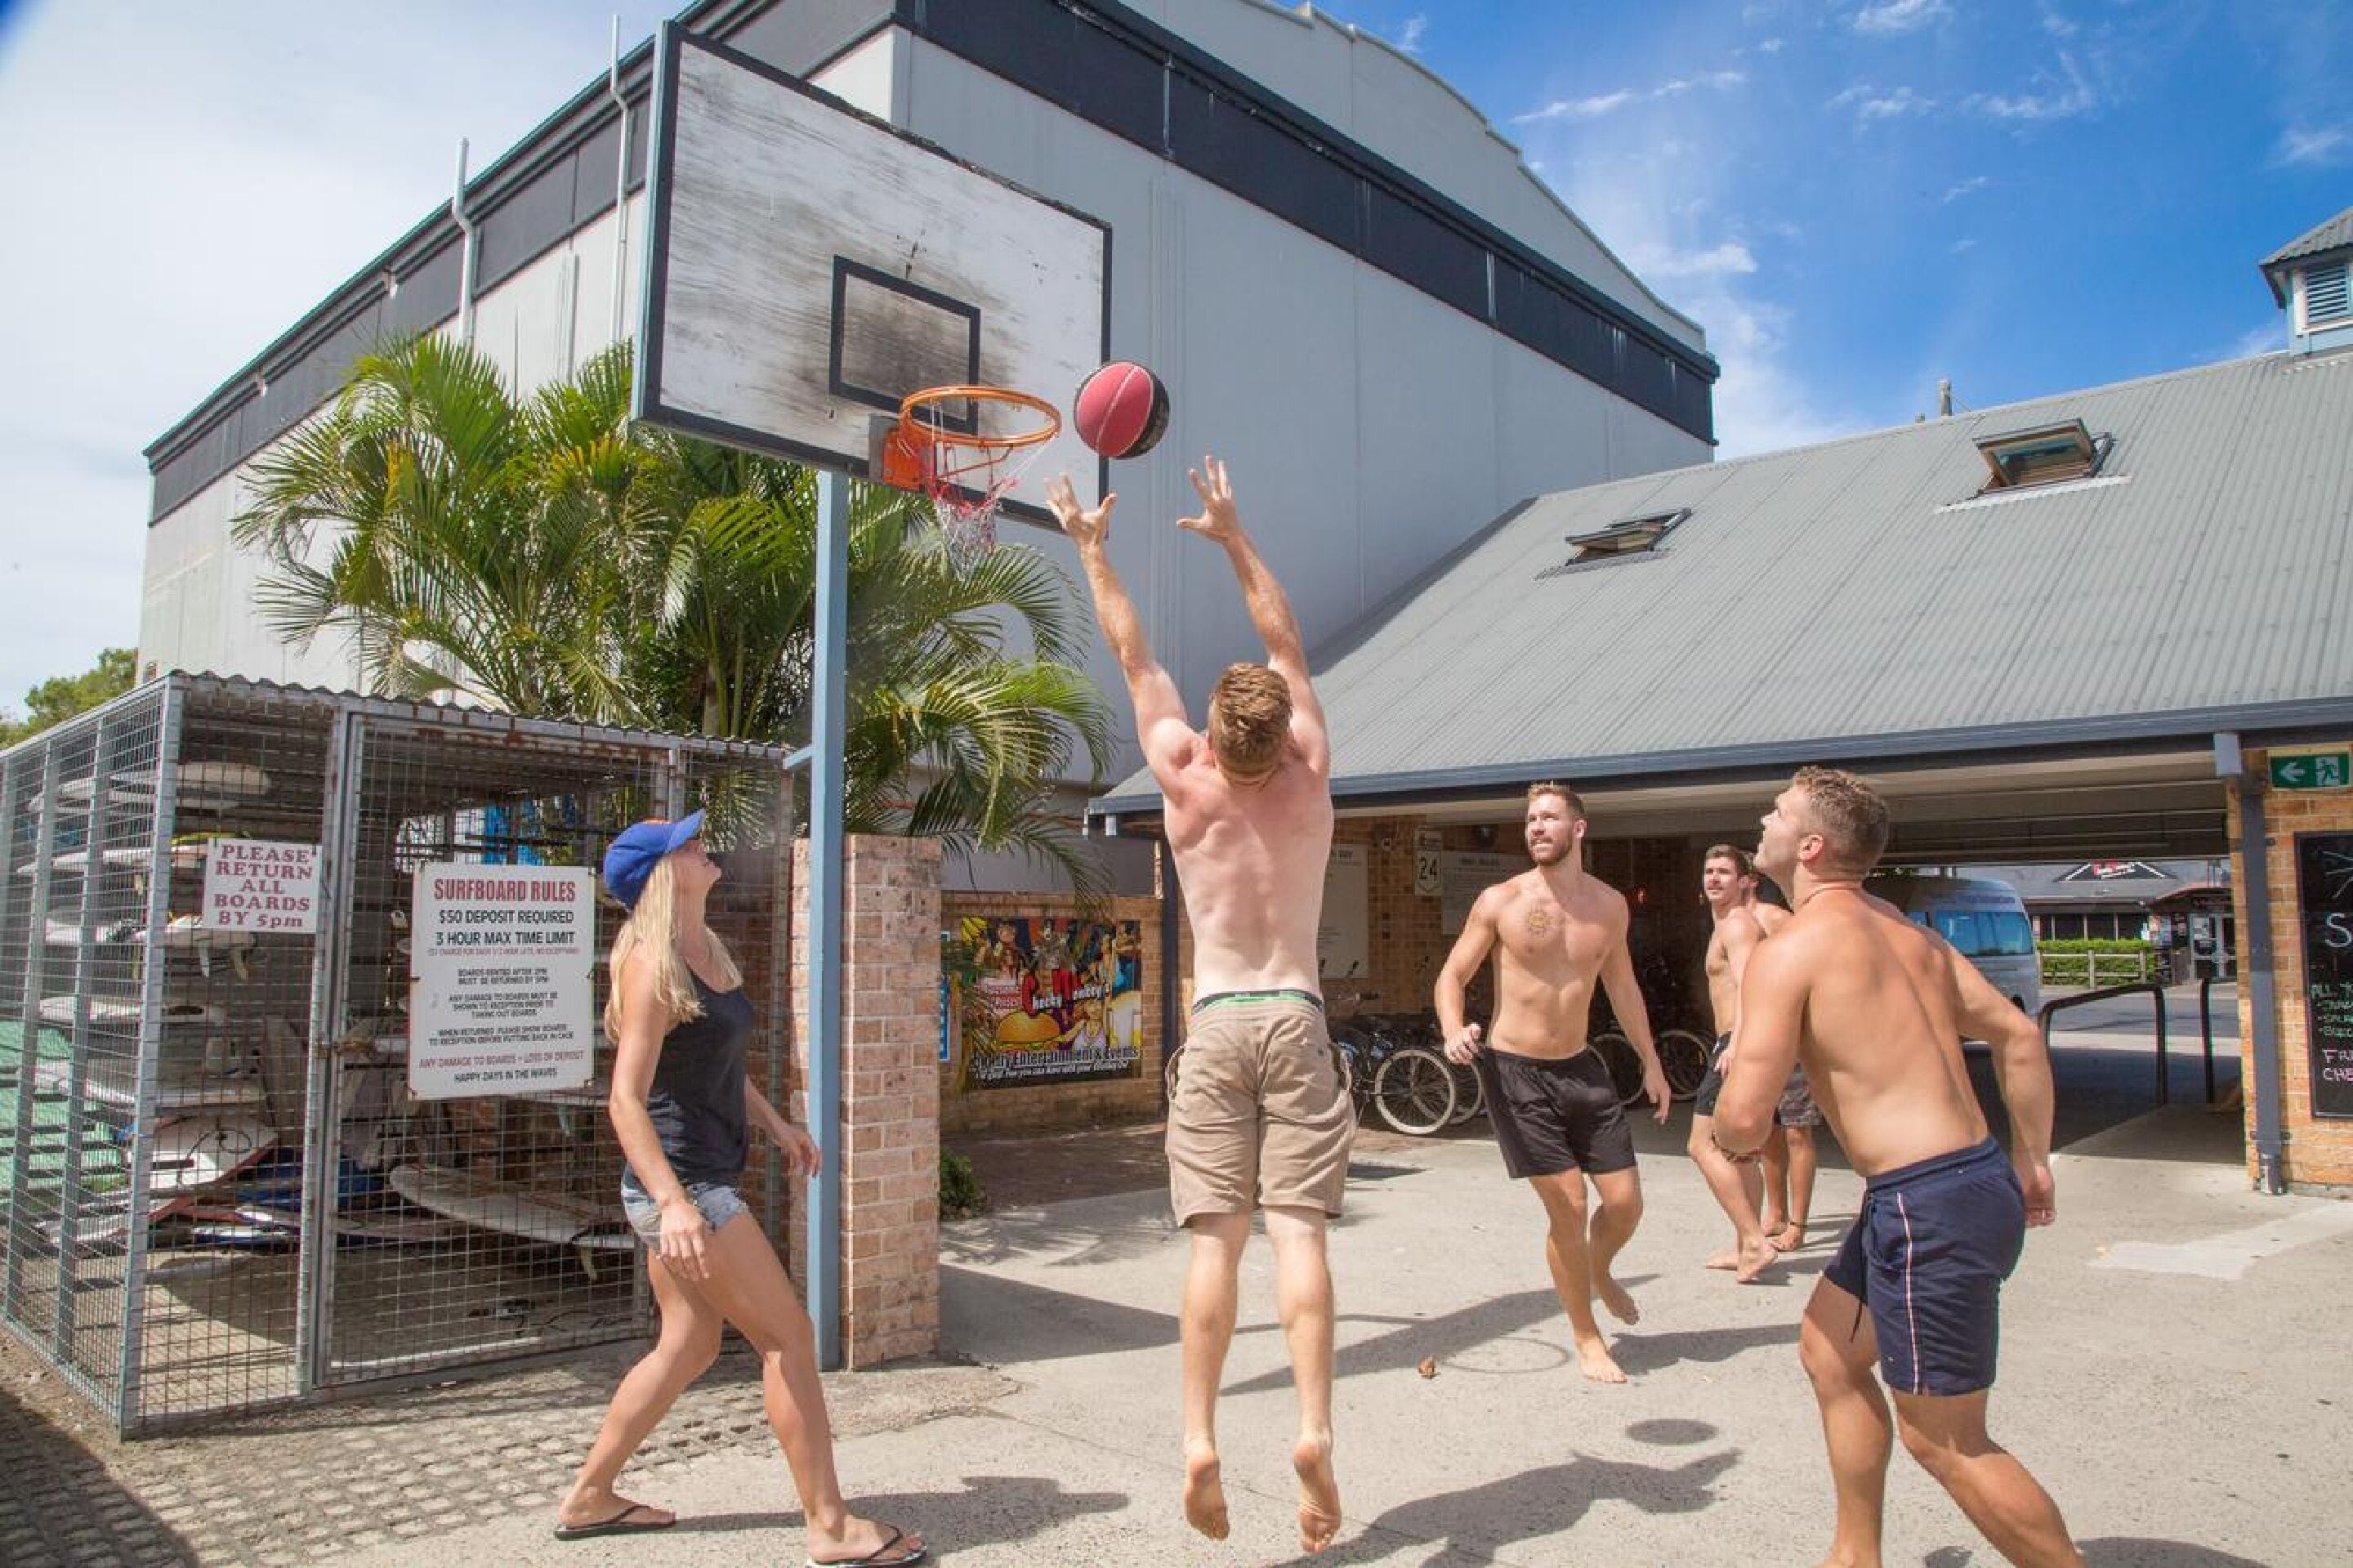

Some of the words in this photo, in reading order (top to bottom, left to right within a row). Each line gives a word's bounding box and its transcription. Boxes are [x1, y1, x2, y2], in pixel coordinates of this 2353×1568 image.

[221, 845, 310, 864] PLEASE
[216, 860, 312, 879] RETURN
[1419, 857, 1437, 879] 24
[239, 879, 285, 894] ALL
[434, 879, 527, 902] SURFBOARD
[530, 881, 575, 902] RULES
[214, 894, 310, 911] BOARDS
[218, 911, 249, 926] BY
[257, 914, 303, 929] 5pm
[440, 910, 462, 923] $50
[465, 910, 515, 923] DEPOSIT
[517, 910, 574, 924] REQUIRED
[436, 932, 444, 945] 3
[448, 932, 480, 945] HOUR
[484, 931, 511, 944] MAX
[515, 931, 543, 943] TIME
[546, 931, 575, 943] LIMIT
